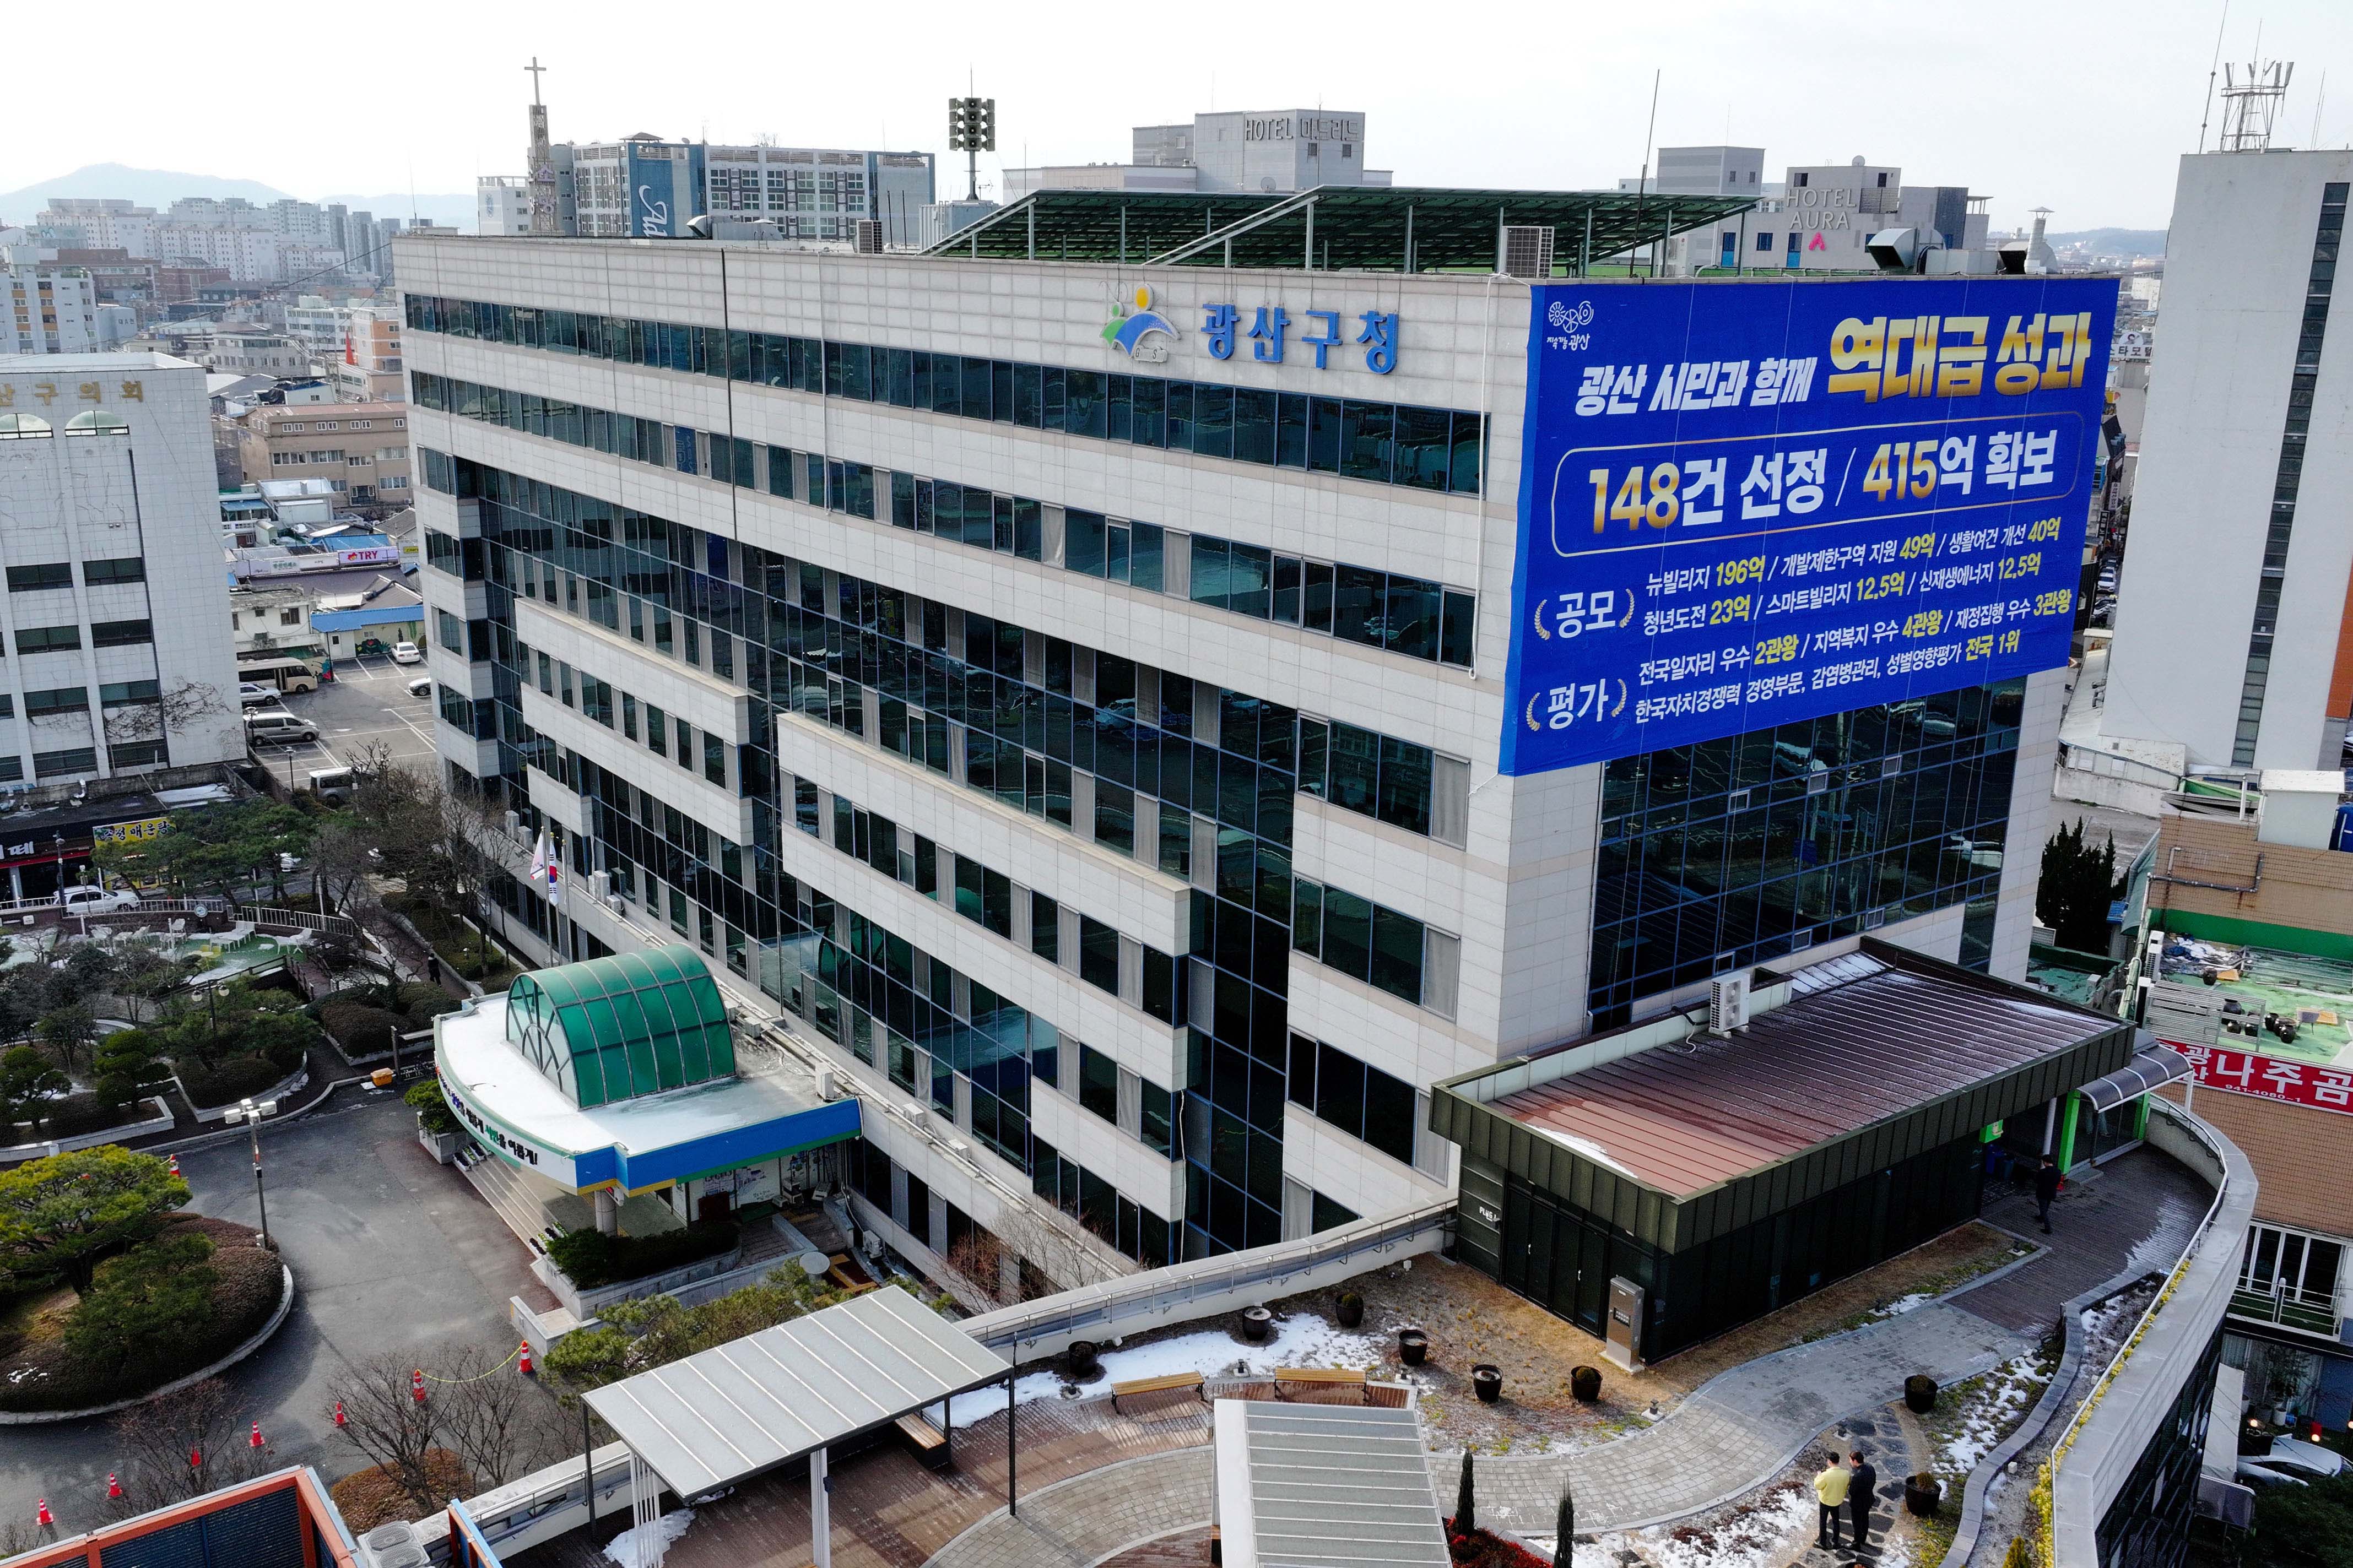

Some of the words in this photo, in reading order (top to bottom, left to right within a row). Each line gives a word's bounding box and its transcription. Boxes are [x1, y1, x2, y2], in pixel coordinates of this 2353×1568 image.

[1246, 118, 1294, 141] HOTEL
[1787, 189, 1857, 208] HOTEL
[1789, 211, 1849, 230] AURA
[1200, 303, 1399, 375] 광산구청
[1827, 316, 1990, 402] 역대급
[1994, 312, 2092, 394] 성과
[1575, 364, 1648, 416] 광산
[1648, 360, 1750, 411] 시민과
[1749, 357, 1818, 406] 함께
[1589, 457, 1727, 533] 148건
[1740, 448, 1827, 520] 선정
[1863, 435, 1977, 501] 415억
[1985, 430, 2058, 490] 확보
[359, 551, 378, 560] TRY
[1646, 565, 1711, 596] 뉴빌리지
[1716, 555, 1766, 587] 196억
[1781, 544, 1866, 577] 개발제한구역
[1868, 540, 1897, 564] 지원
[1899, 532, 1936, 560] 49억
[1949, 527, 1999, 555] 생활여건
[2000, 523, 2026, 546] 개선
[2027, 517, 2062, 542] 40억
[1556, 590, 1616, 638] 공모
[1643, 604, 1706, 636] 청년도전
[1710, 594, 1751, 625] 23억
[1765, 581, 1852, 615] 스마트빌리지
[1857, 571, 1905, 601] 12.5억
[1919, 561, 1994, 592] 신재생에너지
[1998, 552, 2041, 580] 12.5억
[1638, 650, 1716, 686] 전국일자리
[1719, 645, 1751, 671] 우수
[1754, 634, 1799, 665] 2관왕
[1813, 623, 1869, 653] 지역복지
[1871, 620, 1899, 644] 우수
[1902, 609, 1944, 638] 4관왕
[1955, 601, 2005, 630] 재정집행
[2006, 598, 2031, 621] 우수
[2033, 589, 2072, 616] 3관왕
[1548, 678, 1609, 730] 평가
[1635, 682, 1741, 724] 한국자치경쟁력
[1746, 671, 1805, 703] 경영부문,
[1811, 657, 1881, 690] 감염병관리,
[1886, 642, 1962, 676] 성별영향평가
[1965, 634, 1994, 661] 전국
[1999, 629, 2020, 654] 1위
[130, 821, 170, 838] 매운탕
